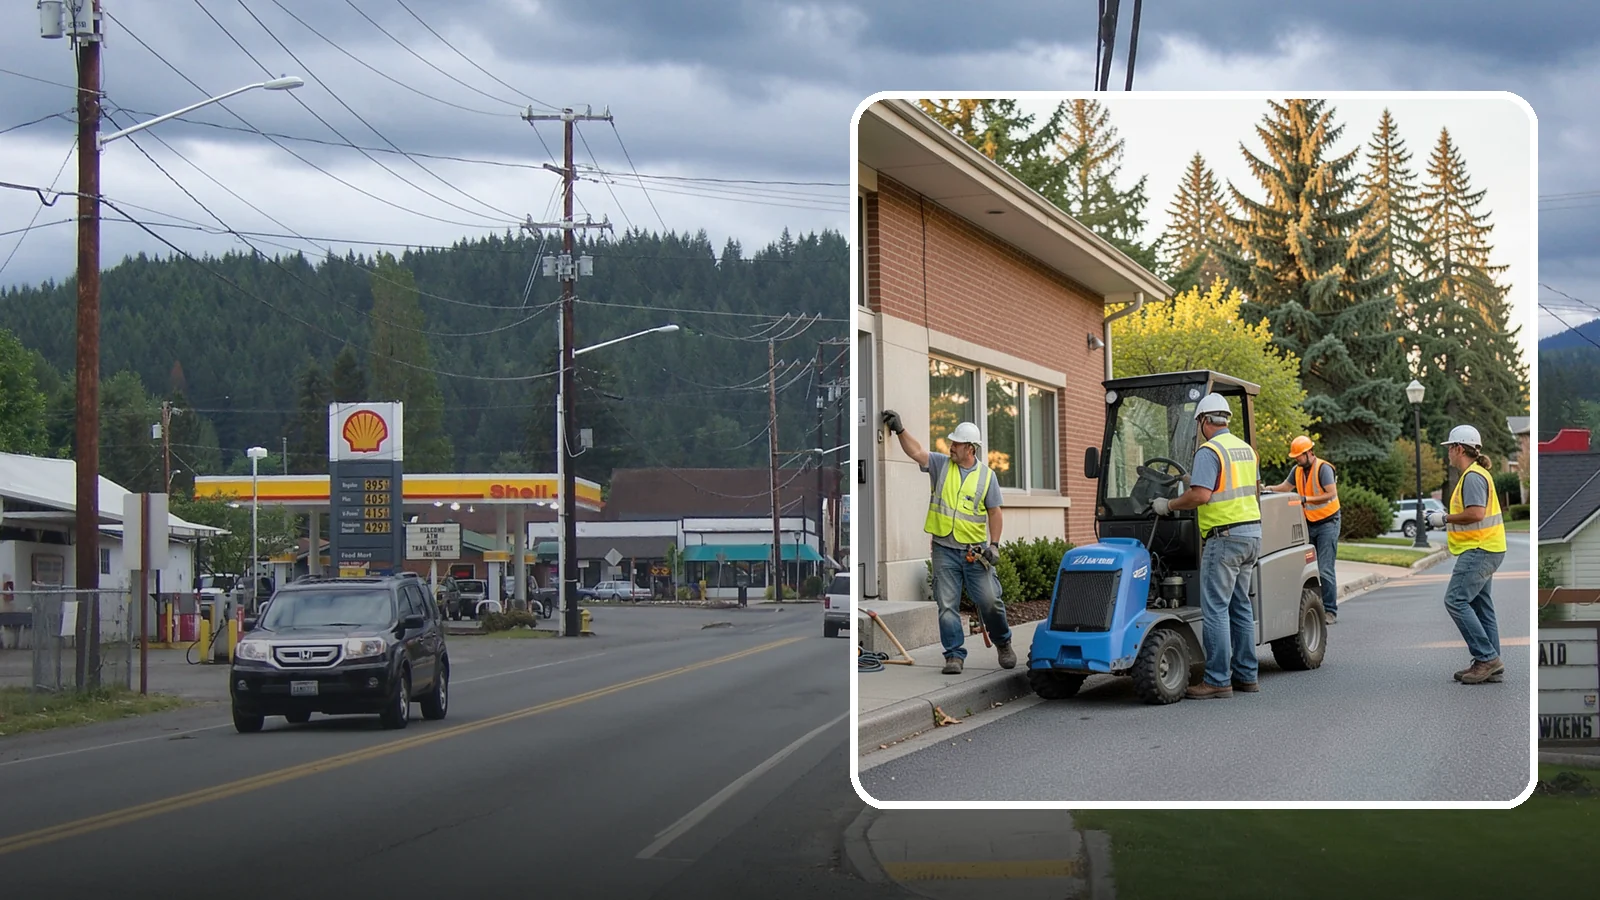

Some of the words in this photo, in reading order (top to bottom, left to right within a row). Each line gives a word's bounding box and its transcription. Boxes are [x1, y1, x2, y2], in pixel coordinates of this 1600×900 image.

[366, 480, 383, 490] 395
[490, 484, 547, 499] Shell
[366, 494, 383, 504] 405
[365, 508, 383, 518] 415
[366, 522, 383, 532] 429
